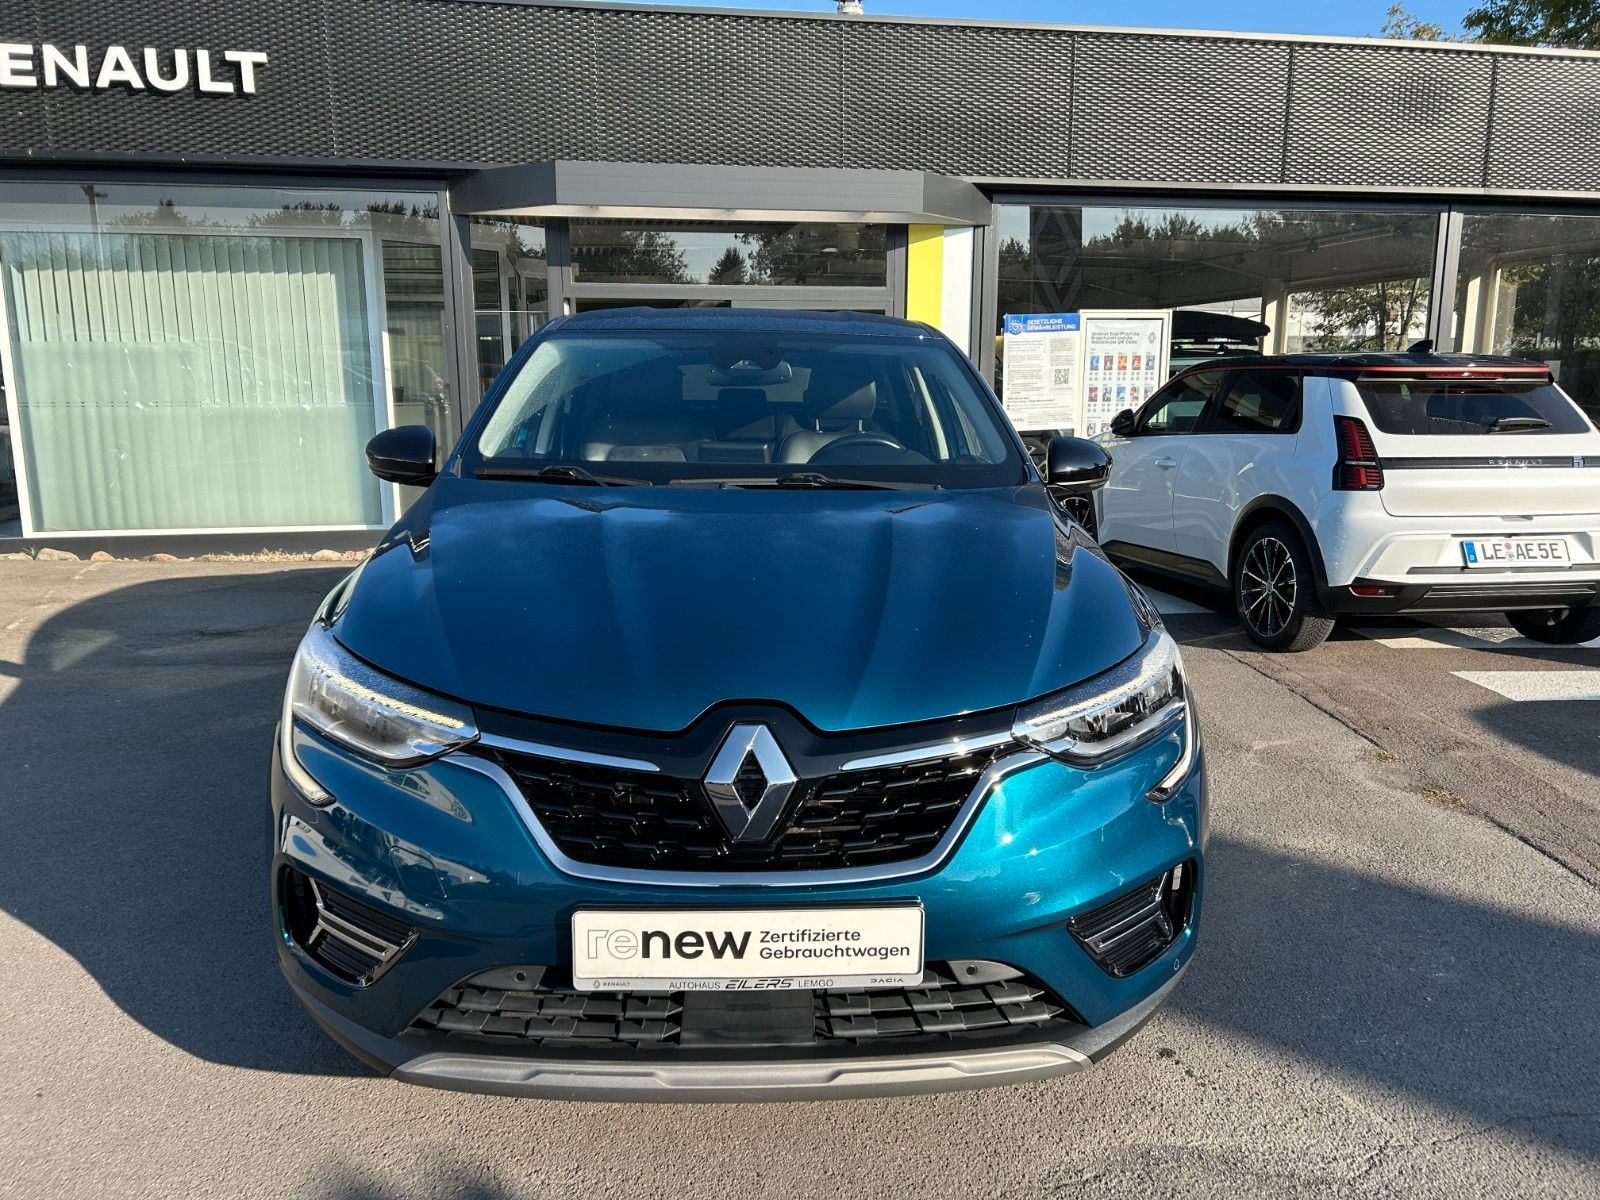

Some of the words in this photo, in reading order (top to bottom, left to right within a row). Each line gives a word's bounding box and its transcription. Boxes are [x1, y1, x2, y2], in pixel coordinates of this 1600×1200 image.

[1481, 543, 1506, 560] LE
[759, 929, 861, 943] Zertifizierte
[587, 929, 751, 959] renew
[759, 945, 910, 960] Gebrauchtwagen
[668, 981, 721, 990] AUTOHAUS
[725, 979, 793, 989] EILERS
[798, 979, 834, 988] LEMGO
